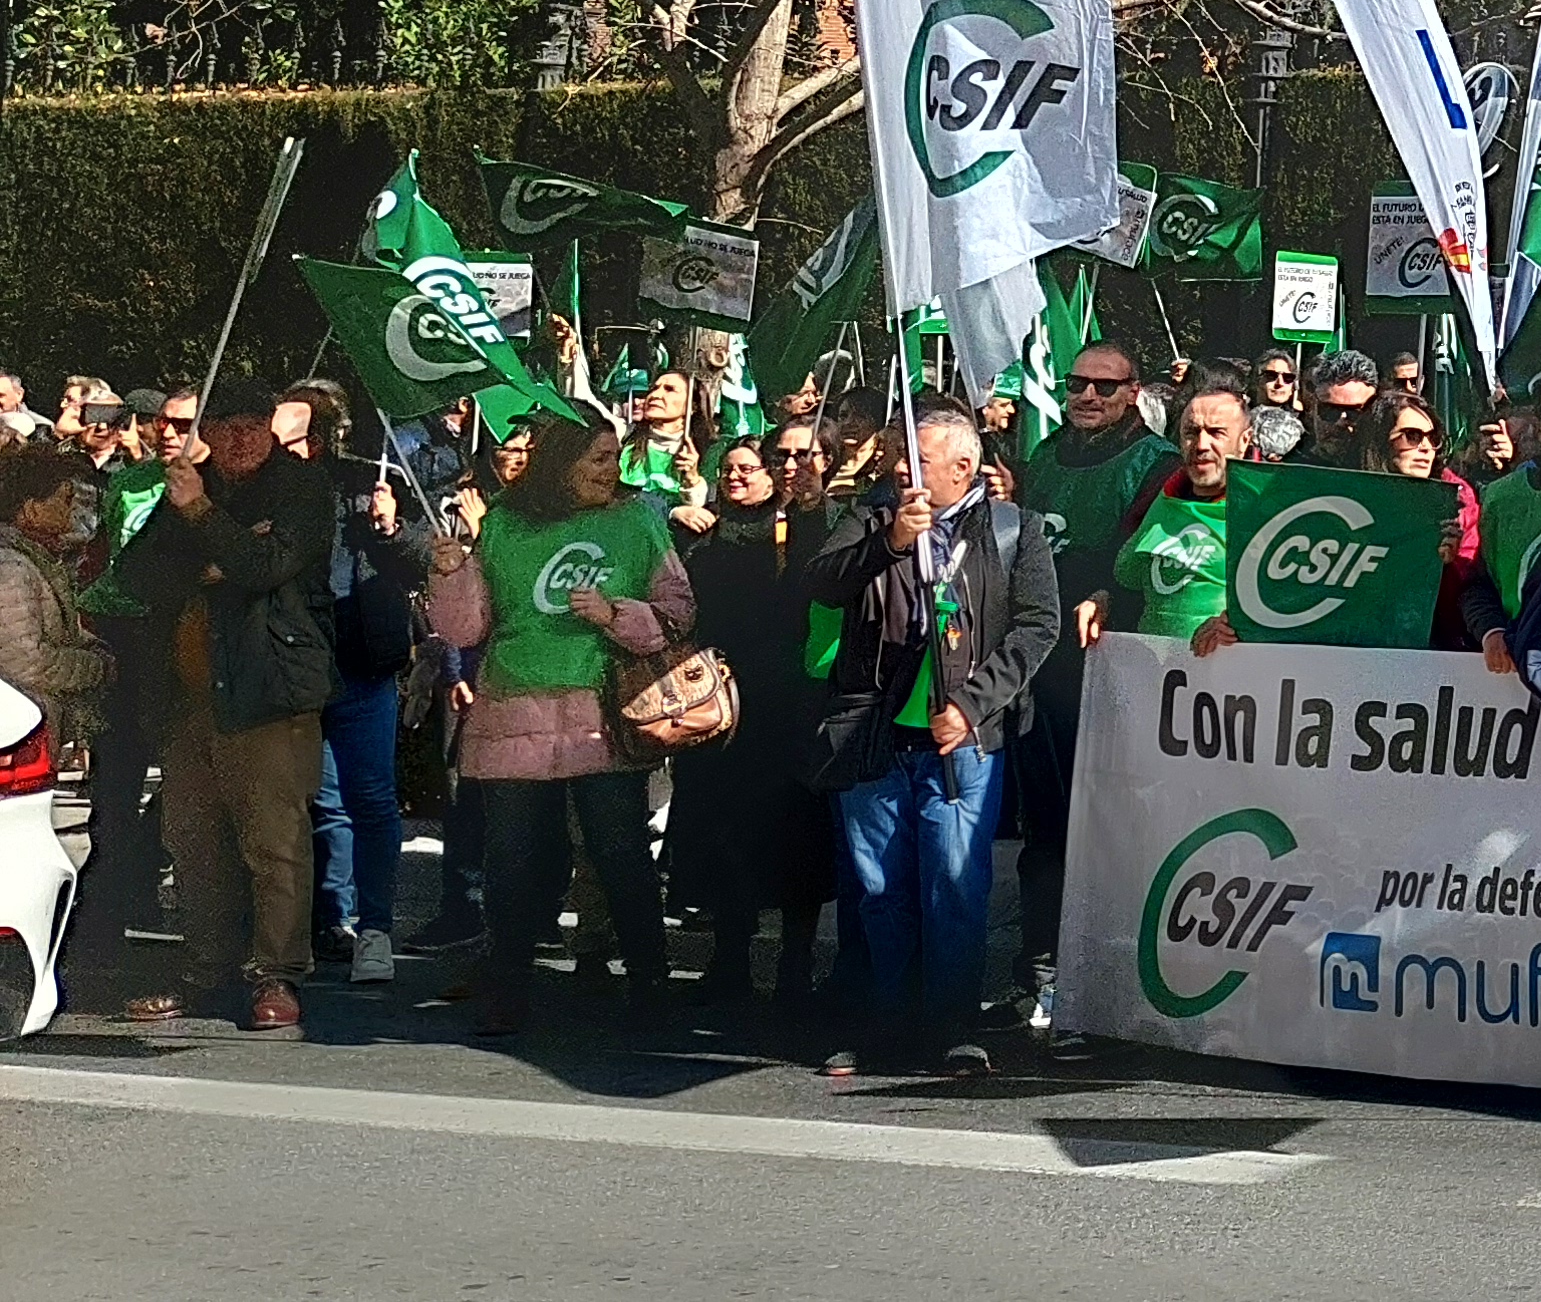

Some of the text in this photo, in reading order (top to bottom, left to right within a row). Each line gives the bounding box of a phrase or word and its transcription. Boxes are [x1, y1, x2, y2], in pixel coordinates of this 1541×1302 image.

[925, 55, 1082, 131] CSIF
[1373, 204, 1380, 212] EL
[1383, 203, 1416, 212] FUTURO
[1406, 216, 1429, 224] JUEG
[1408, 254, 1444, 271] CSIF
[417, 277, 505, 345] CSIF
[1298, 301, 1318, 313] CSIF
[550, 563, 615, 589] CSIF
[1267, 535, 1389, 588] CSIF
[1159, 668, 1256, 763] Con
[1275, 678, 1331, 769] la
[1350, 685, 1541, 780] salud
[1166, 870, 1313, 953] CSIF
[1376, 869, 1433, 913] por
[1436, 863, 1467, 911] la
